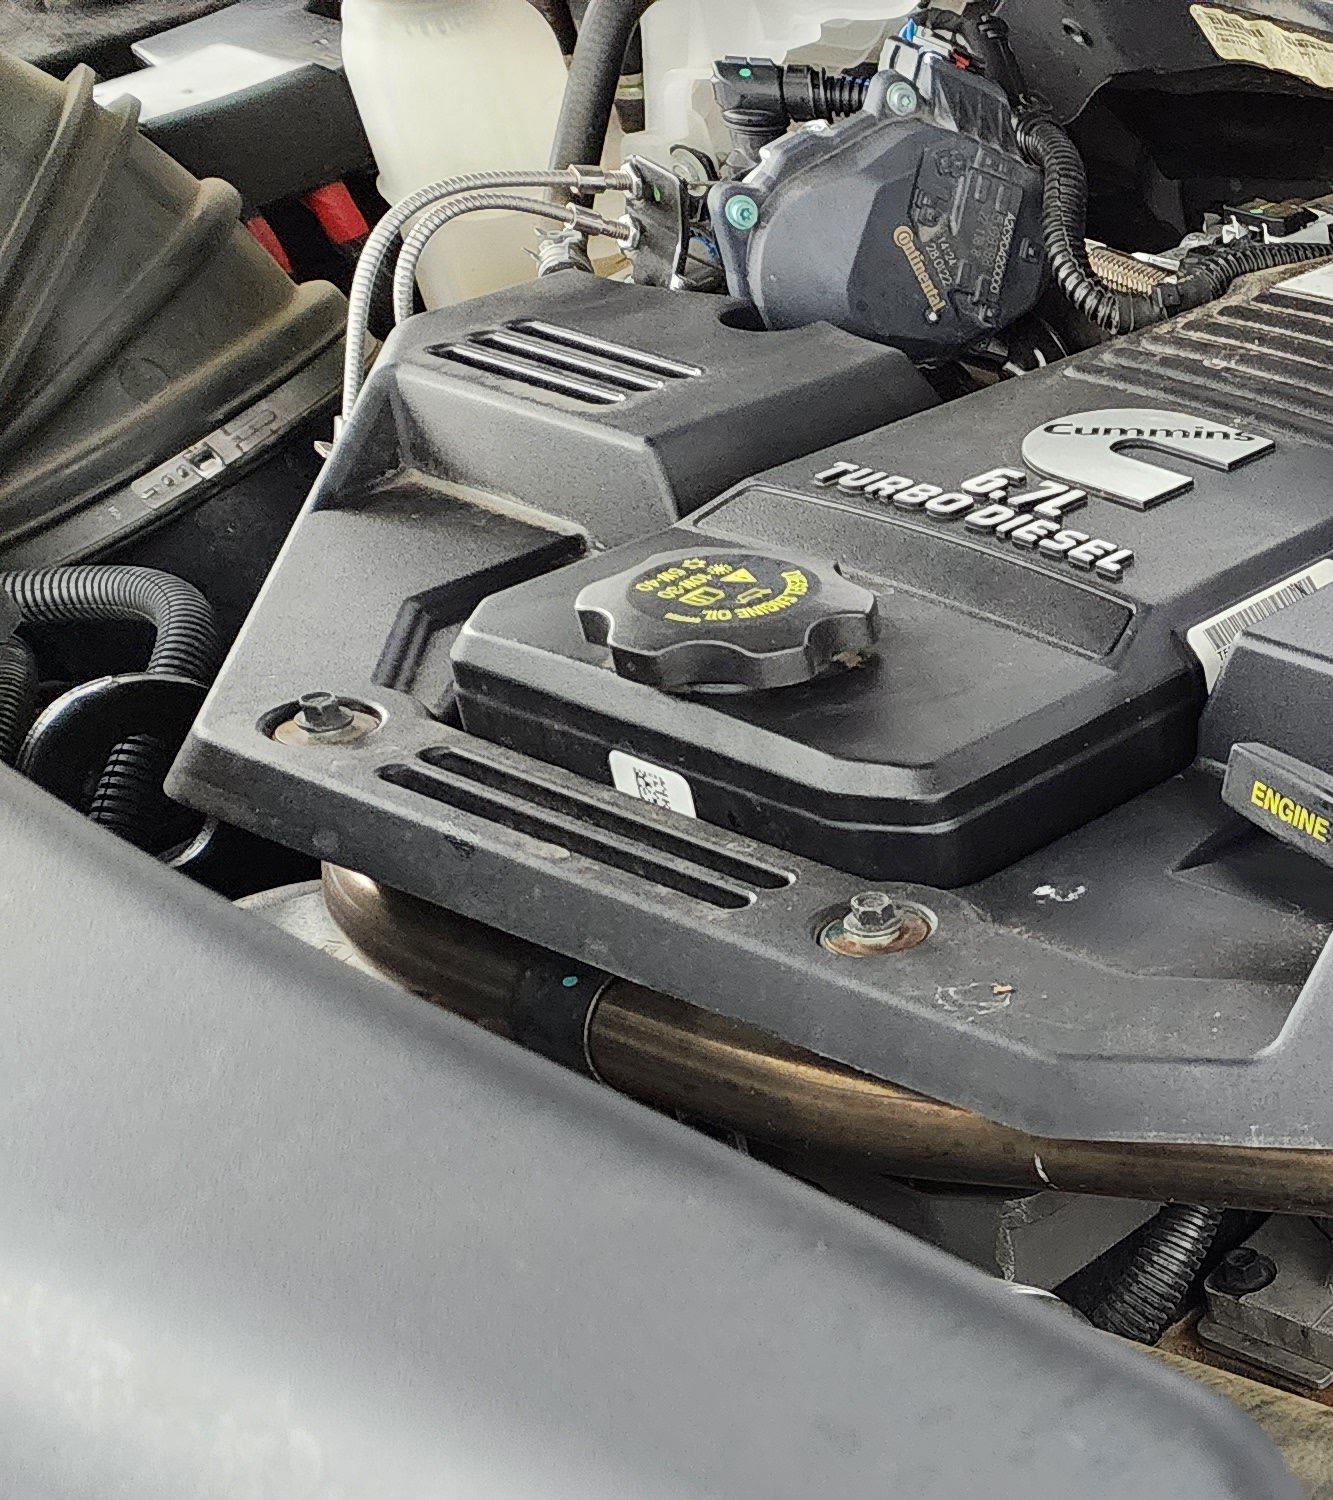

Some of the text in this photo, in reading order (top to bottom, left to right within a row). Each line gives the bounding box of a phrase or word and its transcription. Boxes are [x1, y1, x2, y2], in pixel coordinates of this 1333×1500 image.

[893, 225, 946, 312] Continental
[1043, 422, 1256, 443] Cummins
[961, 467, 1088, 519] 6.7L
[814, 461, 1135, 579] TURBO DIESEL
[703, 608, 733, 621] OIL
[735, 595, 799, 619] ENGINE
[1251, 780, 1331, 843] ENGINE
